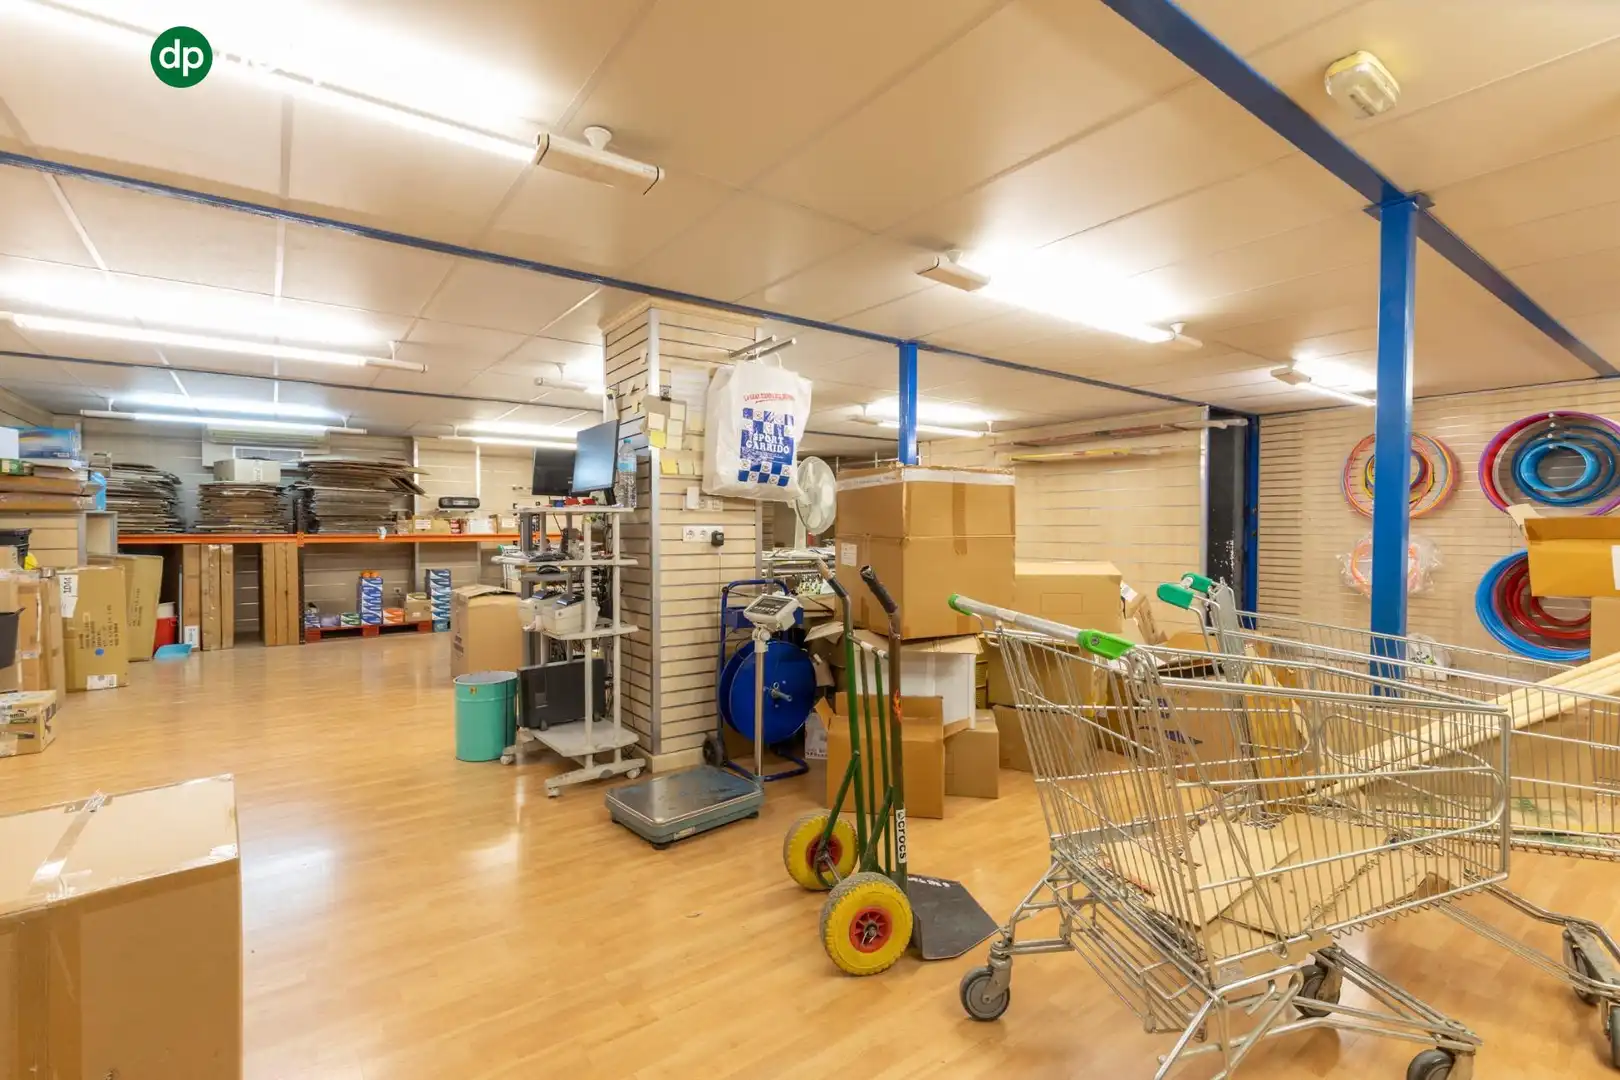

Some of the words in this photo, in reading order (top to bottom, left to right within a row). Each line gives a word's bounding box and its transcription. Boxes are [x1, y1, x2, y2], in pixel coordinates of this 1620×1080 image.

[753, 433, 784, 445] SPORT
[746, 440, 790, 454] GARRIDO
[898, 820, 907, 859] crocs
